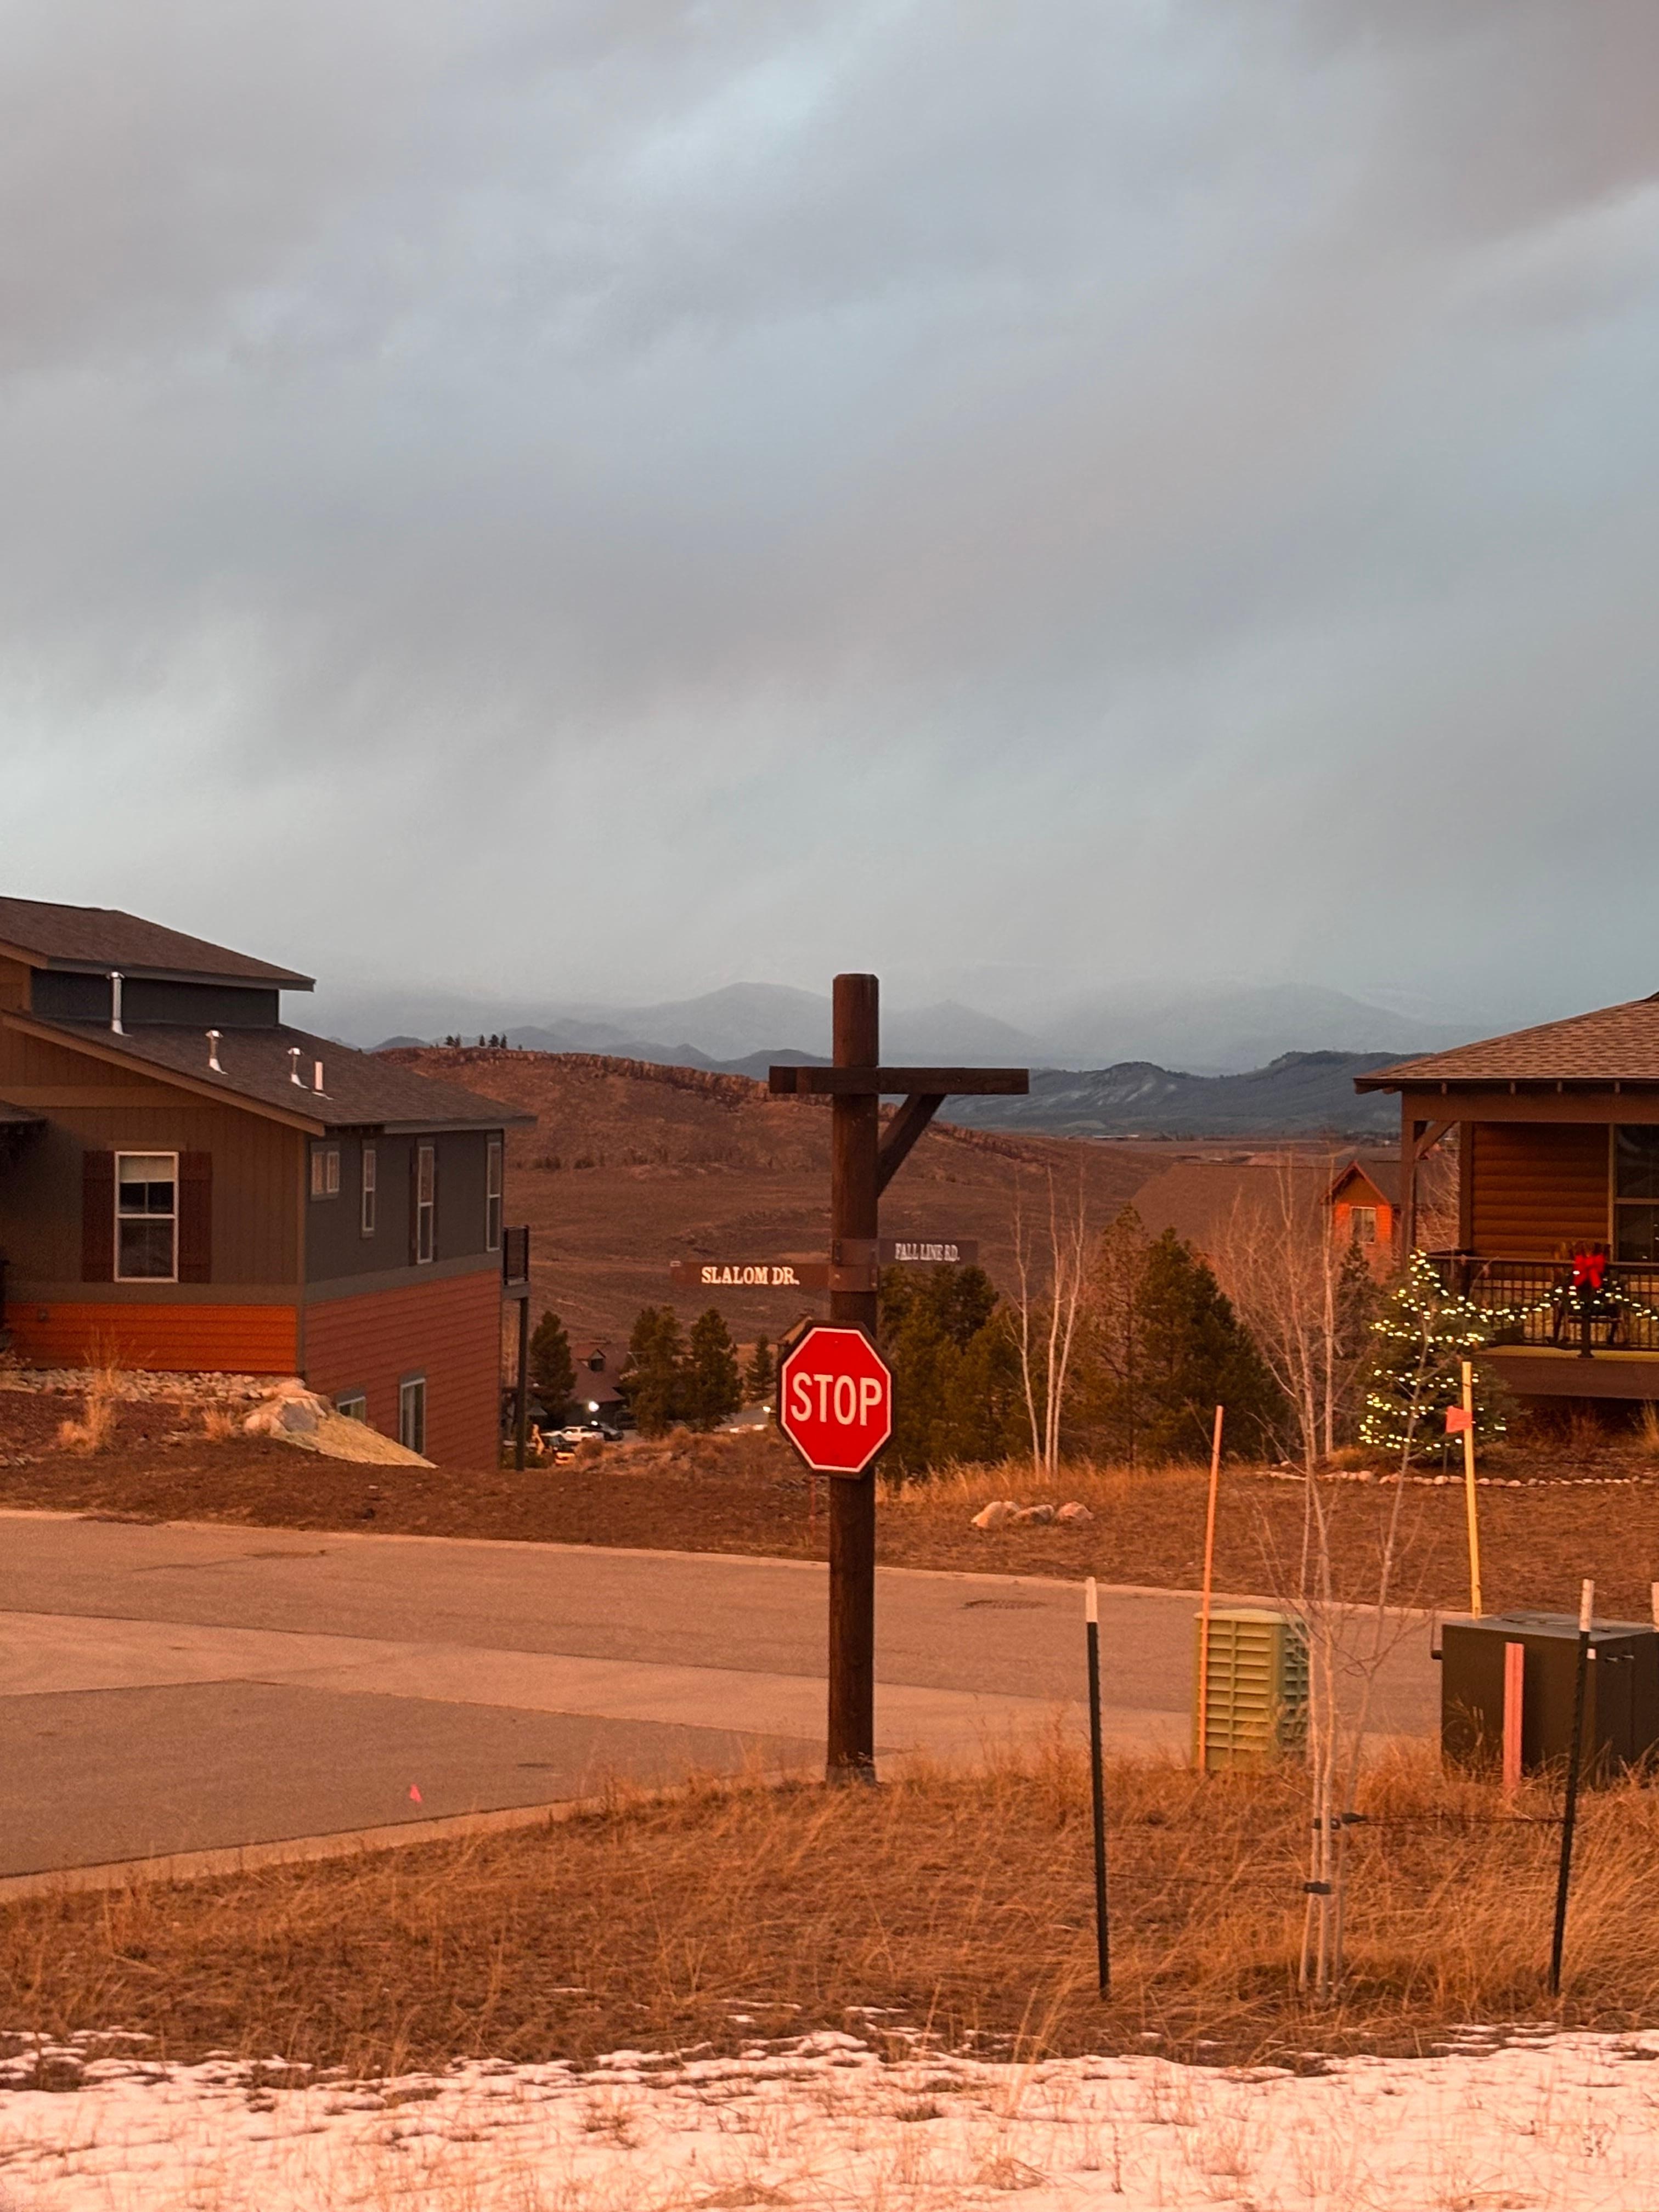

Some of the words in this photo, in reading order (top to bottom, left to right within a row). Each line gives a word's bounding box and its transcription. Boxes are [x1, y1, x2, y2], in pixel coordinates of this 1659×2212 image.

[895, 1243, 919, 1261] FALL
[920, 1243, 943, 1261] LINE
[944, 1244, 960, 1262] RD.
[701, 1266, 769, 1284] SLALOM
[771, 1267, 800, 1285] DR.
[791, 1372, 883, 1426] STOP
